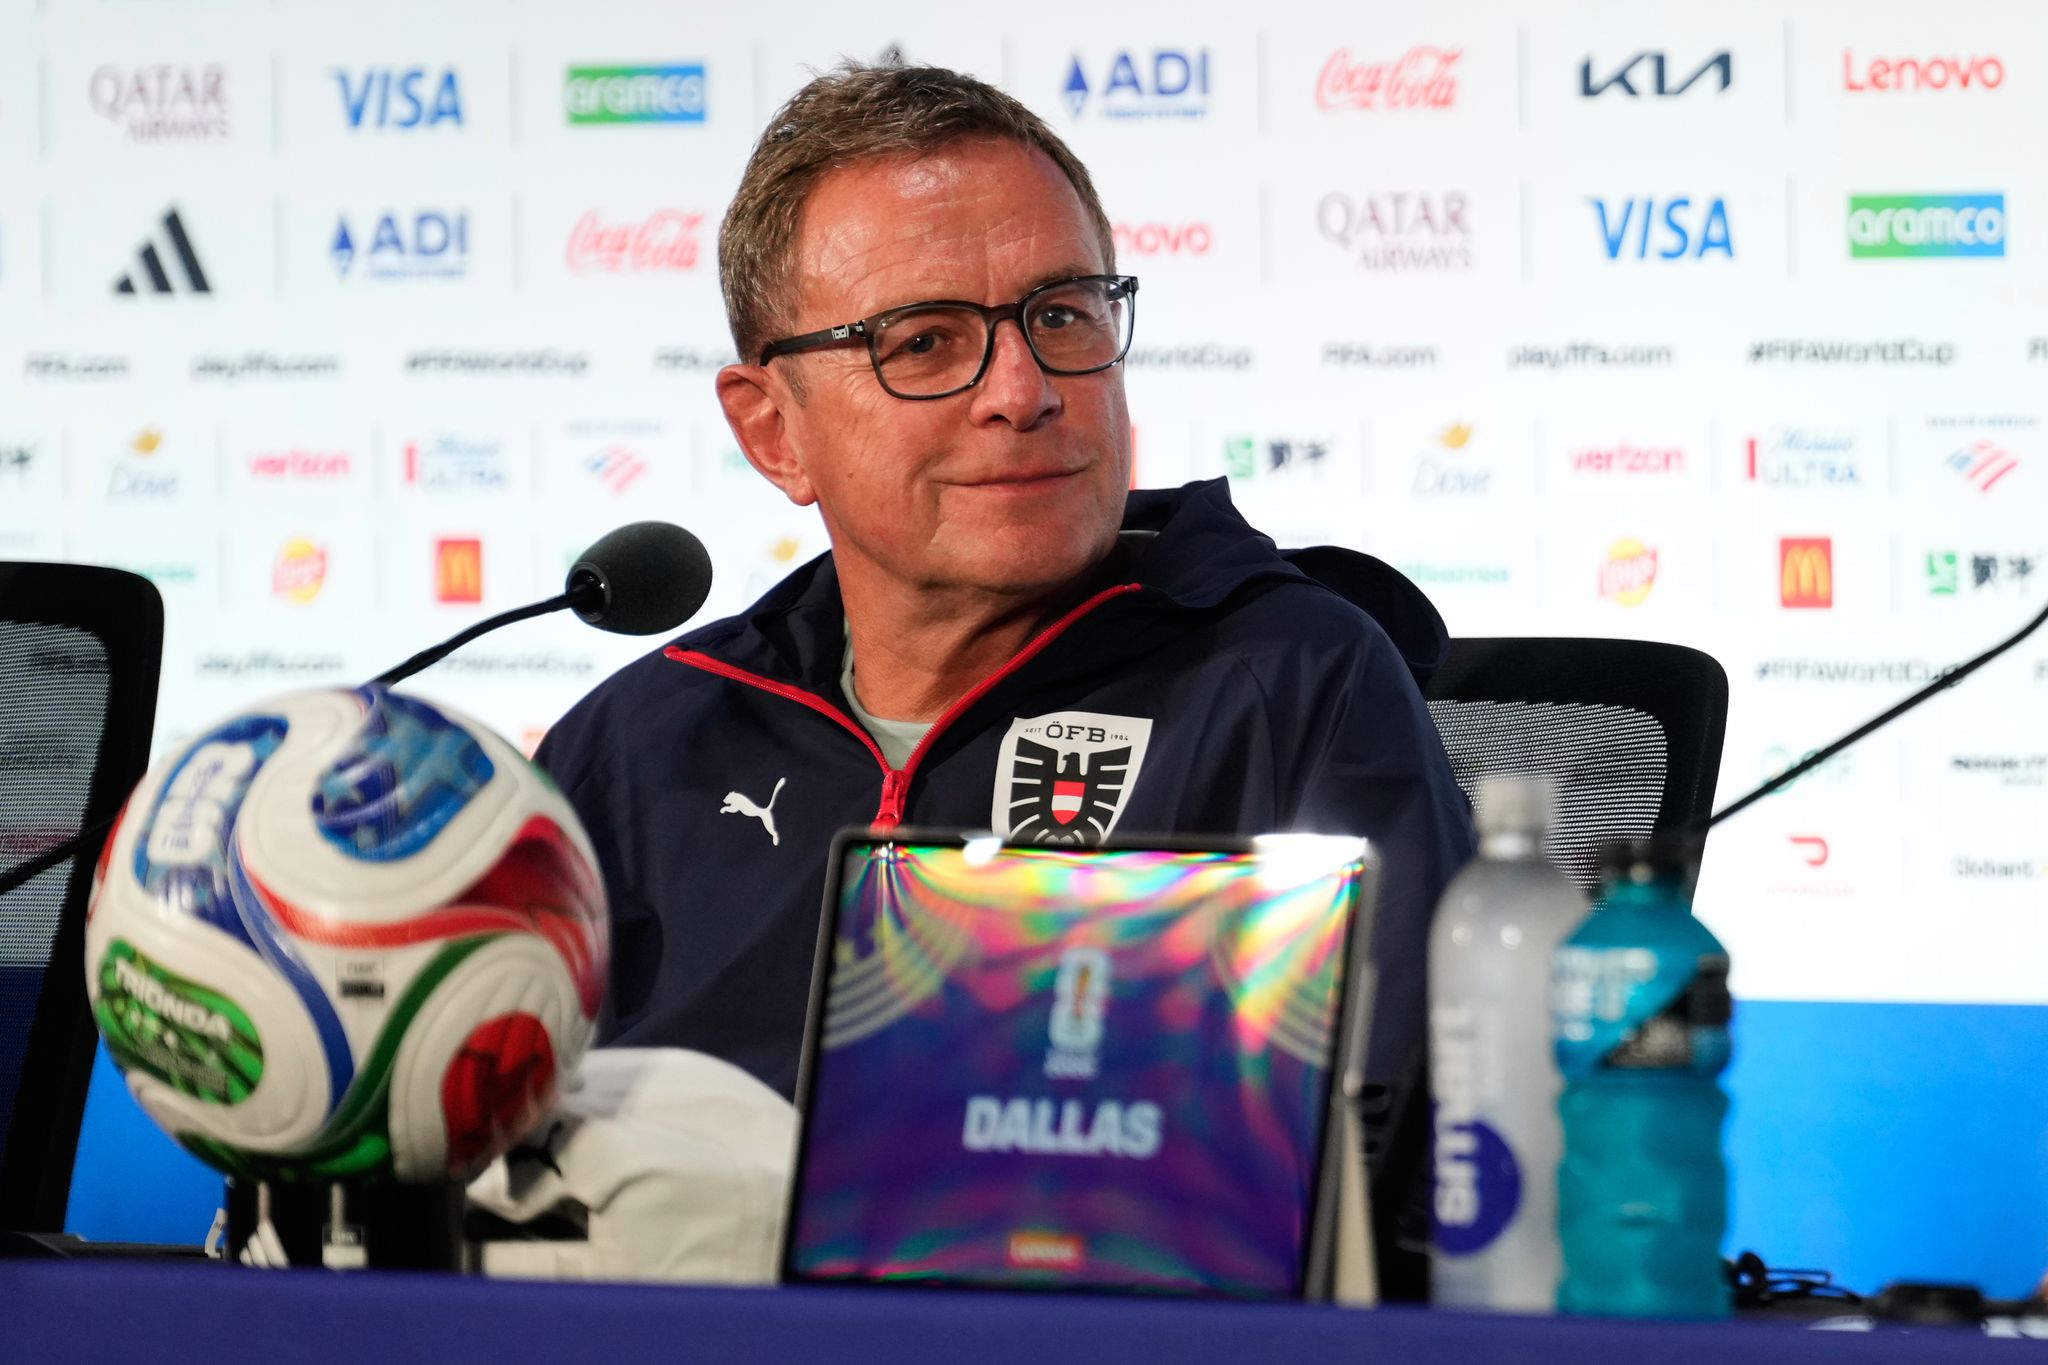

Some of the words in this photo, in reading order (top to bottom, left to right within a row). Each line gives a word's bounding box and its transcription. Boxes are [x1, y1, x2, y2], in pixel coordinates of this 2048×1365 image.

[88, 64, 227, 120] QATAR
[1105, 51, 1211, 97] ADI
[1843, 50, 2005, 91] Lenovo
[328, 67, 464, 127] VISA
[565, 75, 706, 116] aramco
[368, 211, 469, 257] ADI
[1112, 222, 1214, 254] novo
[1317, 192, 1473, 246] QATAR
[1588, 197, 1734, 259] VISA
[1848, 206, 2005, 247] aramco
[1356, 246, 1473, 271] AIRWAYS
[1747, 338, 1957, 366] #FIFAWorldCup
[1571, 444, 1684, 475] verizon
[1045, 720, 1107, 744] ÖFB
[1110, 733, 1129, 742] 1904
[114, 960, 232, 1037] TRIONDA
[962, 1095, 1165, 1159] DALLAS
